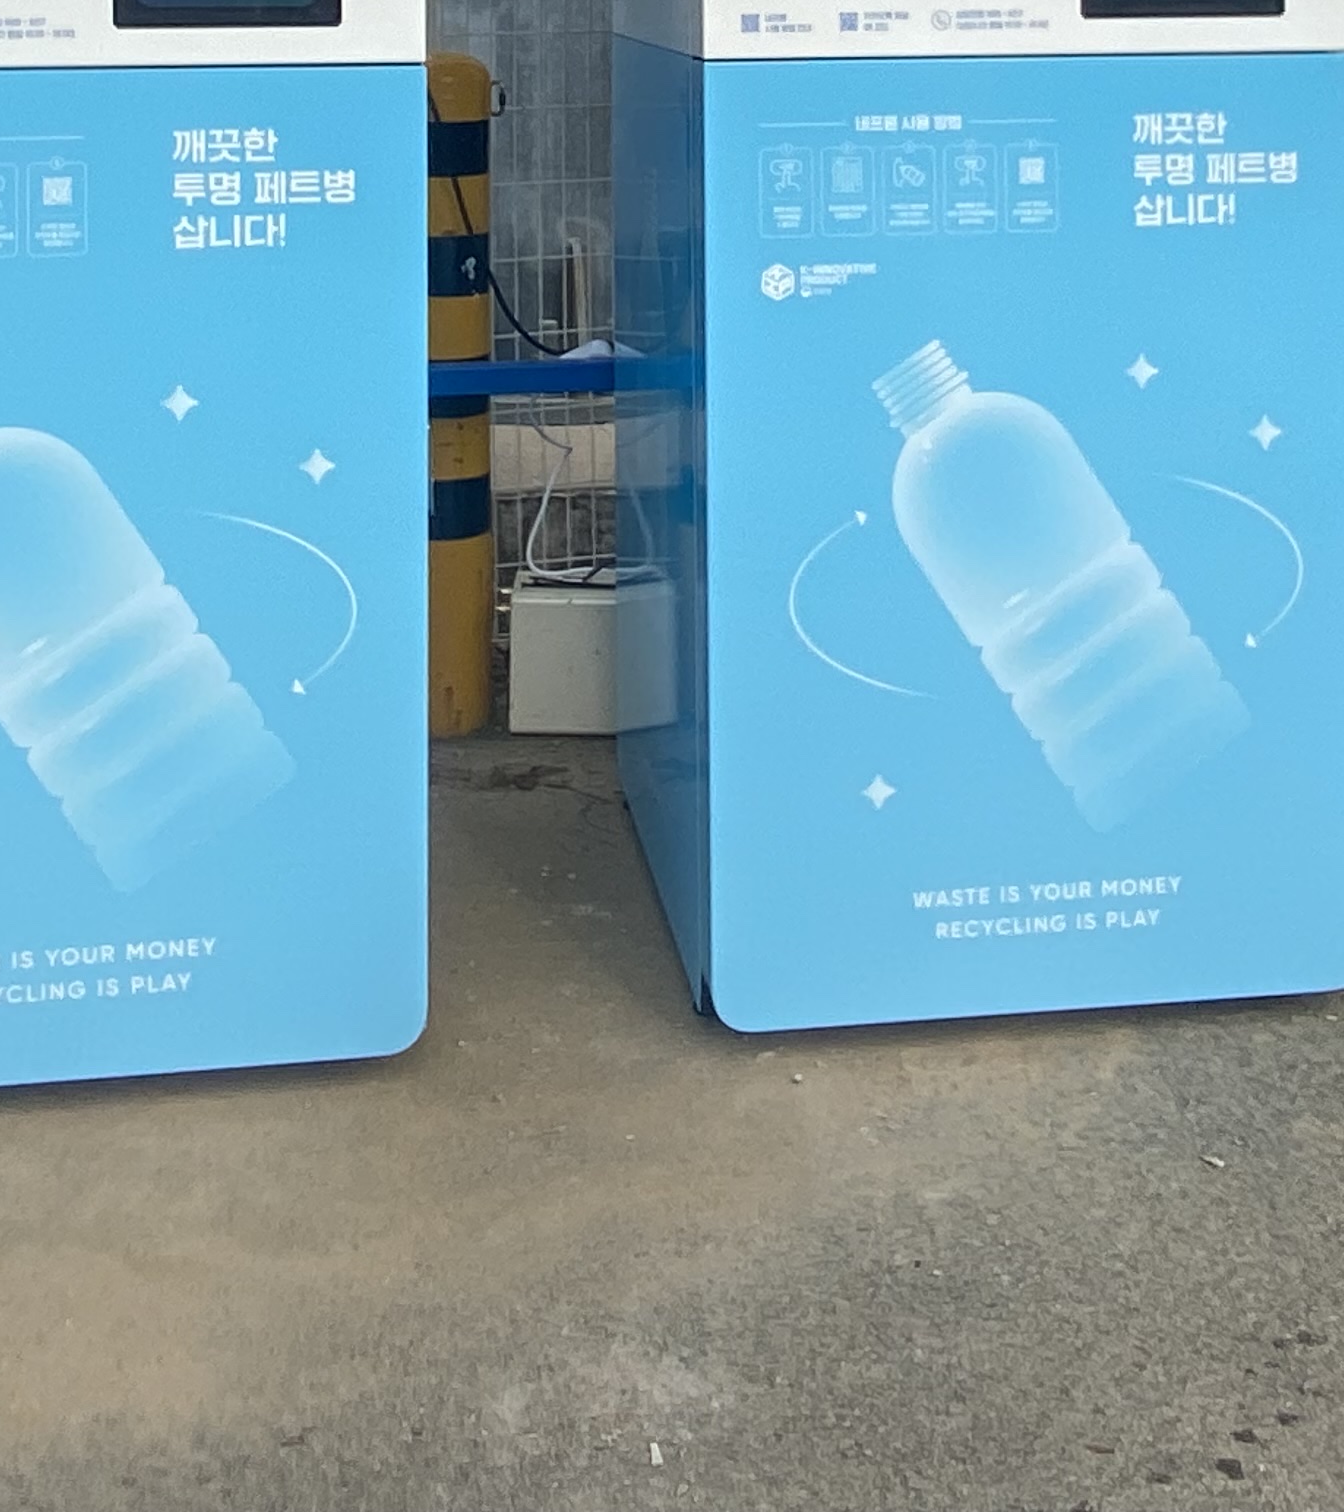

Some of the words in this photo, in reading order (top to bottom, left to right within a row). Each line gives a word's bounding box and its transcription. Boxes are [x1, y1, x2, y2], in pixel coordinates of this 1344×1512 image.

[172, 127, 278, 163] 깨끗한
[1132, 111, 1228, 145] 깨끗한
[1133, 153, 1196, 186] 투명
[1205, 151, 1298, 184] 페트병
[172, 171, 241, 206] 투명
[253, 169, 356, 205] 페트병
[1133, 192, 1235, 227] 삽니다!
[172, 213, 286, 249] 삽니다!
[912, 887, 991, 909] WASTE
[1000, 886, 1021, 903] IS
[1030, 881, 1092, 901] YOUR
[1101, 876, 1182, 898] MONEY
[934, 914, 1067, 940] RECYCLING
[1076, 912, 1097, 929] IS
[1106, 909, 1161, 928] PLAY
[11, 951, 35, 970] IS
[44, 945, 116, 968] YOUR
[125, 937, 217, 962] MONEY
[97, 978, 120, 998] IS
[131, 972, 193, 996] PLAY
